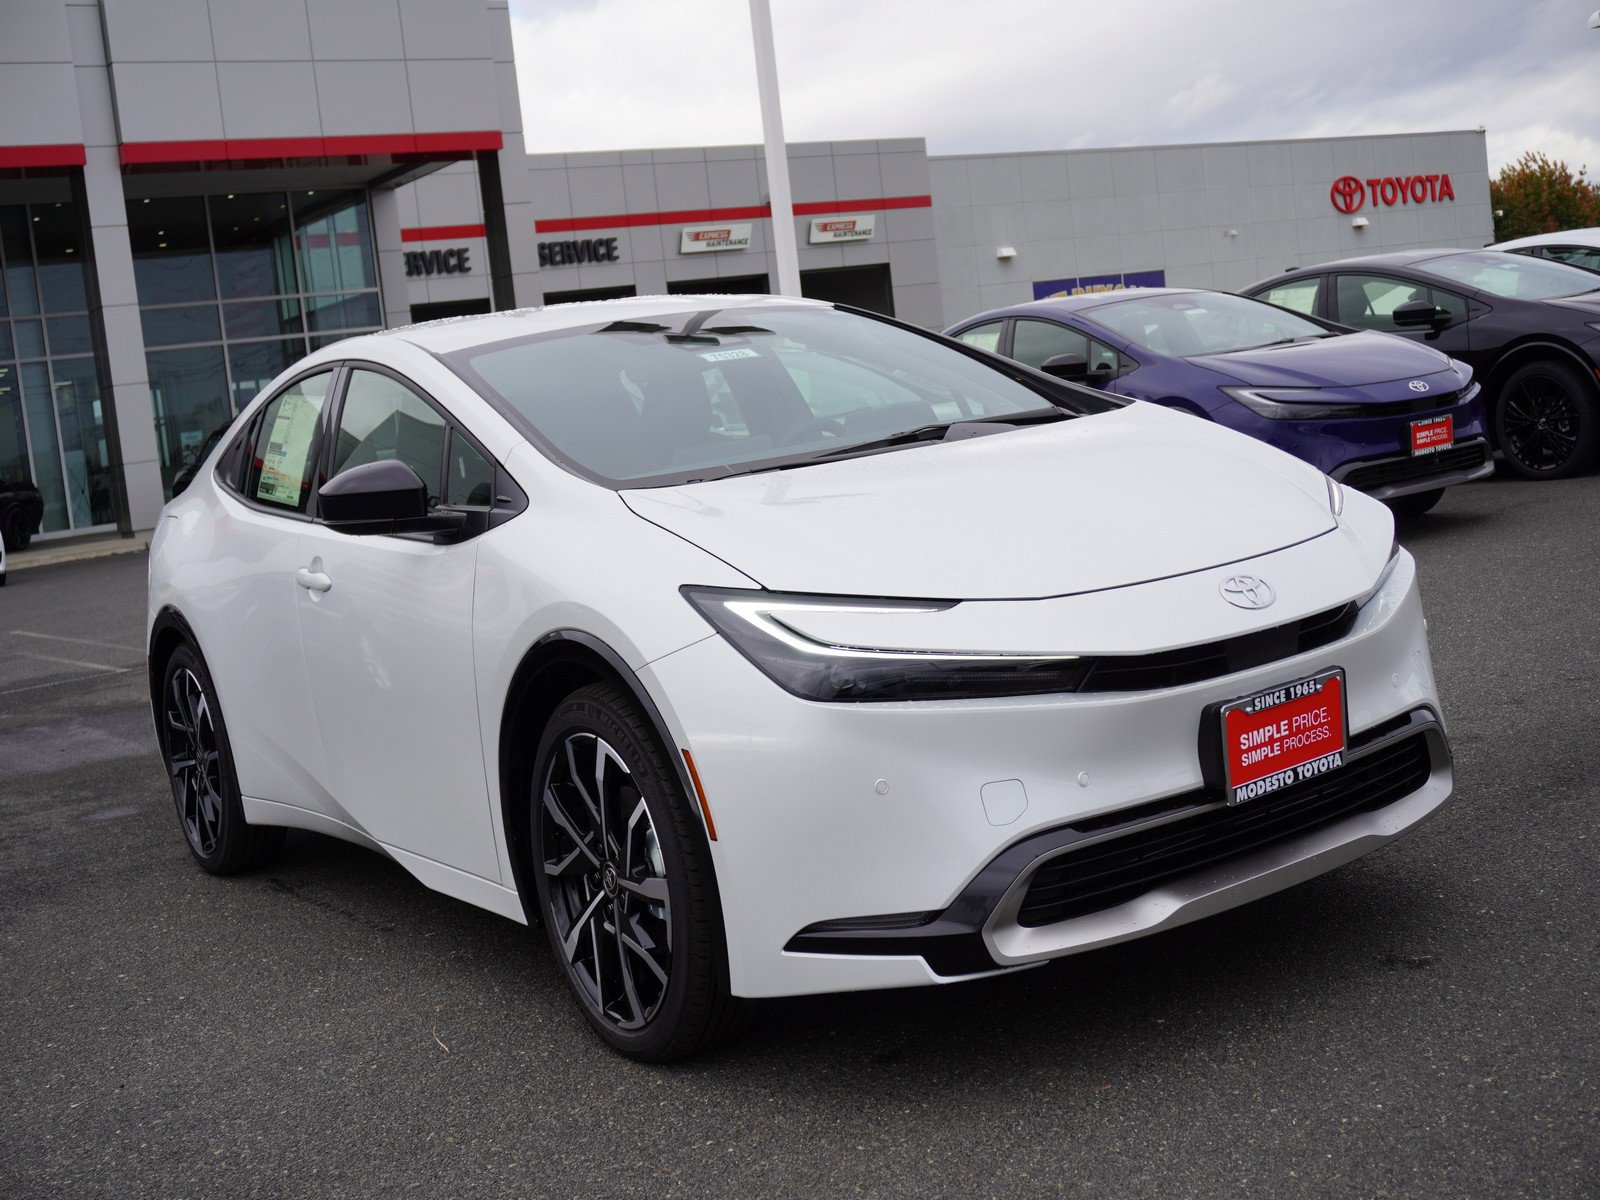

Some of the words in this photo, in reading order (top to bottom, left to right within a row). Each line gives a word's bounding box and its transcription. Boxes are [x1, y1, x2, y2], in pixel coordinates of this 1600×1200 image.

[1366, 174, 1455, 207] TOYOTA
[706, 237, 749, 248] MAINTENANCE
[833, 228, 872, 238] MAINTENANCE
[404, 247, 472, 277] RVICE
[537, 237, 620, 268] SERVICE
[1254, 691, 1286, 711] SINCE
[1290, 680, 1316, 699] 1965
[1239, 719, 1290, 750] SIMPLE
[1292, 706, 1331, 733] PRICE.
[1241, 742, 1281, 767] SIMPLE
[1283, 725, 1332, 752] PROCESS.
[1235, 770, 1295, 803] MODESTO
[1297, 753, 1343, 780] TOYOTA
